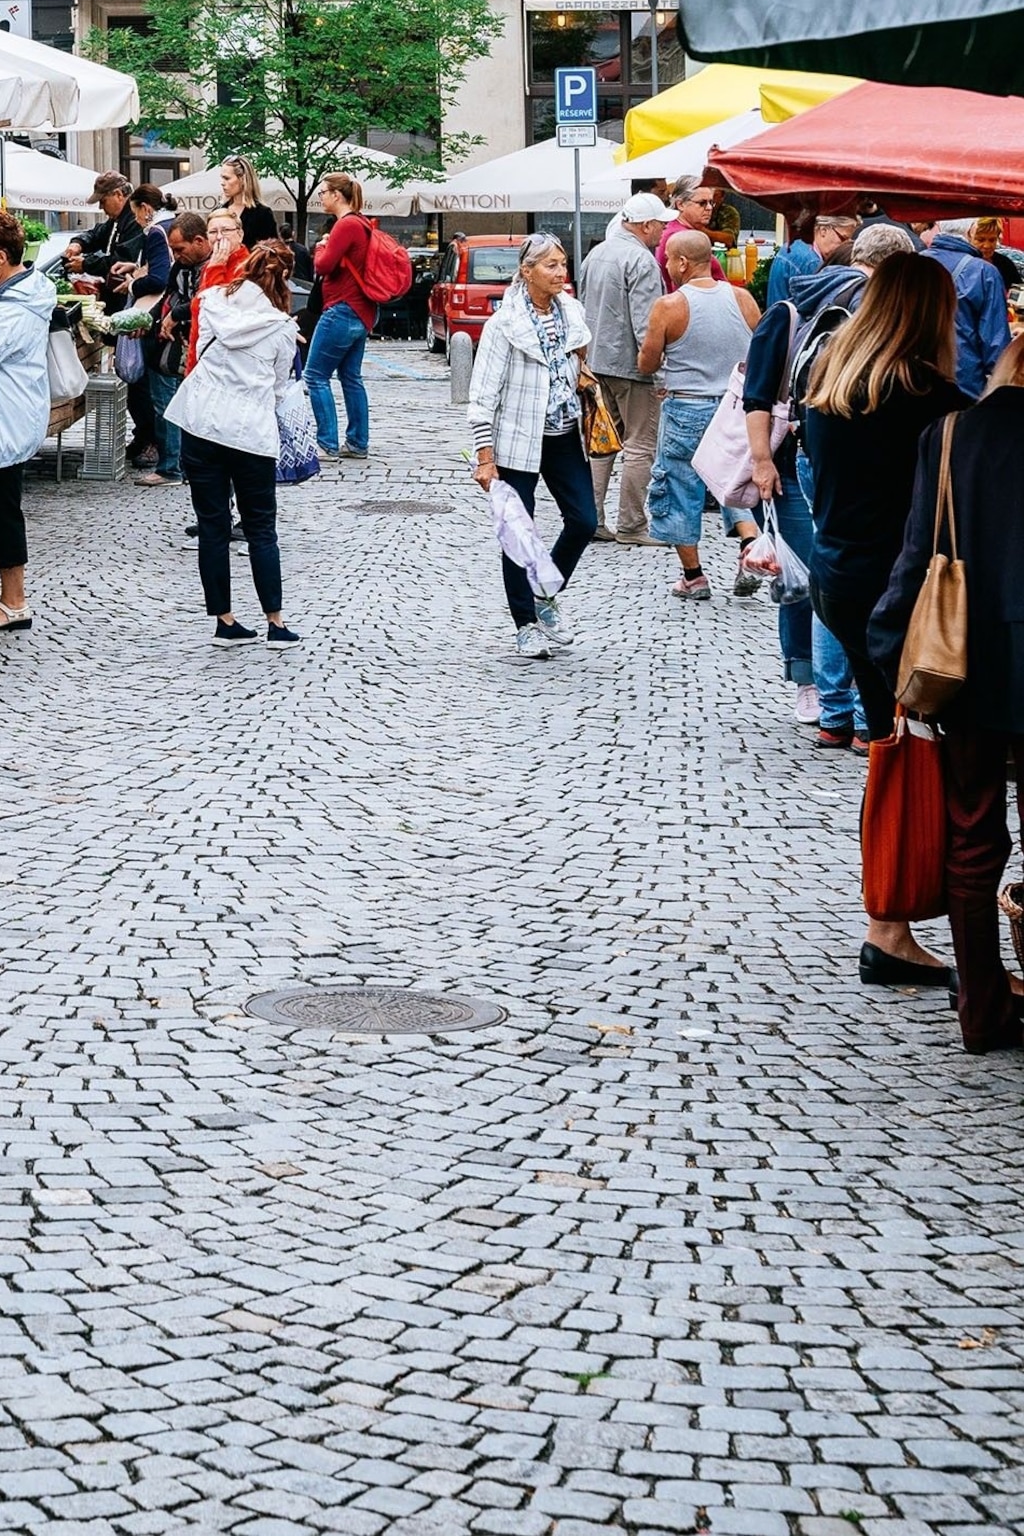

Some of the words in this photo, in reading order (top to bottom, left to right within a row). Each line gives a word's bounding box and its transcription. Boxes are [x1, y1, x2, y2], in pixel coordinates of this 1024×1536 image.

[564, 74, 588, 107] P
[560, 108, 593, 118] RÉSERVÉ
[19, 194, 70, 207] Cosmopolis
[176, 194, 222, 210] ATTO
[434, 194, 511, 209] MATTONI
[579, 196, 627, 210] Cosmopoli
